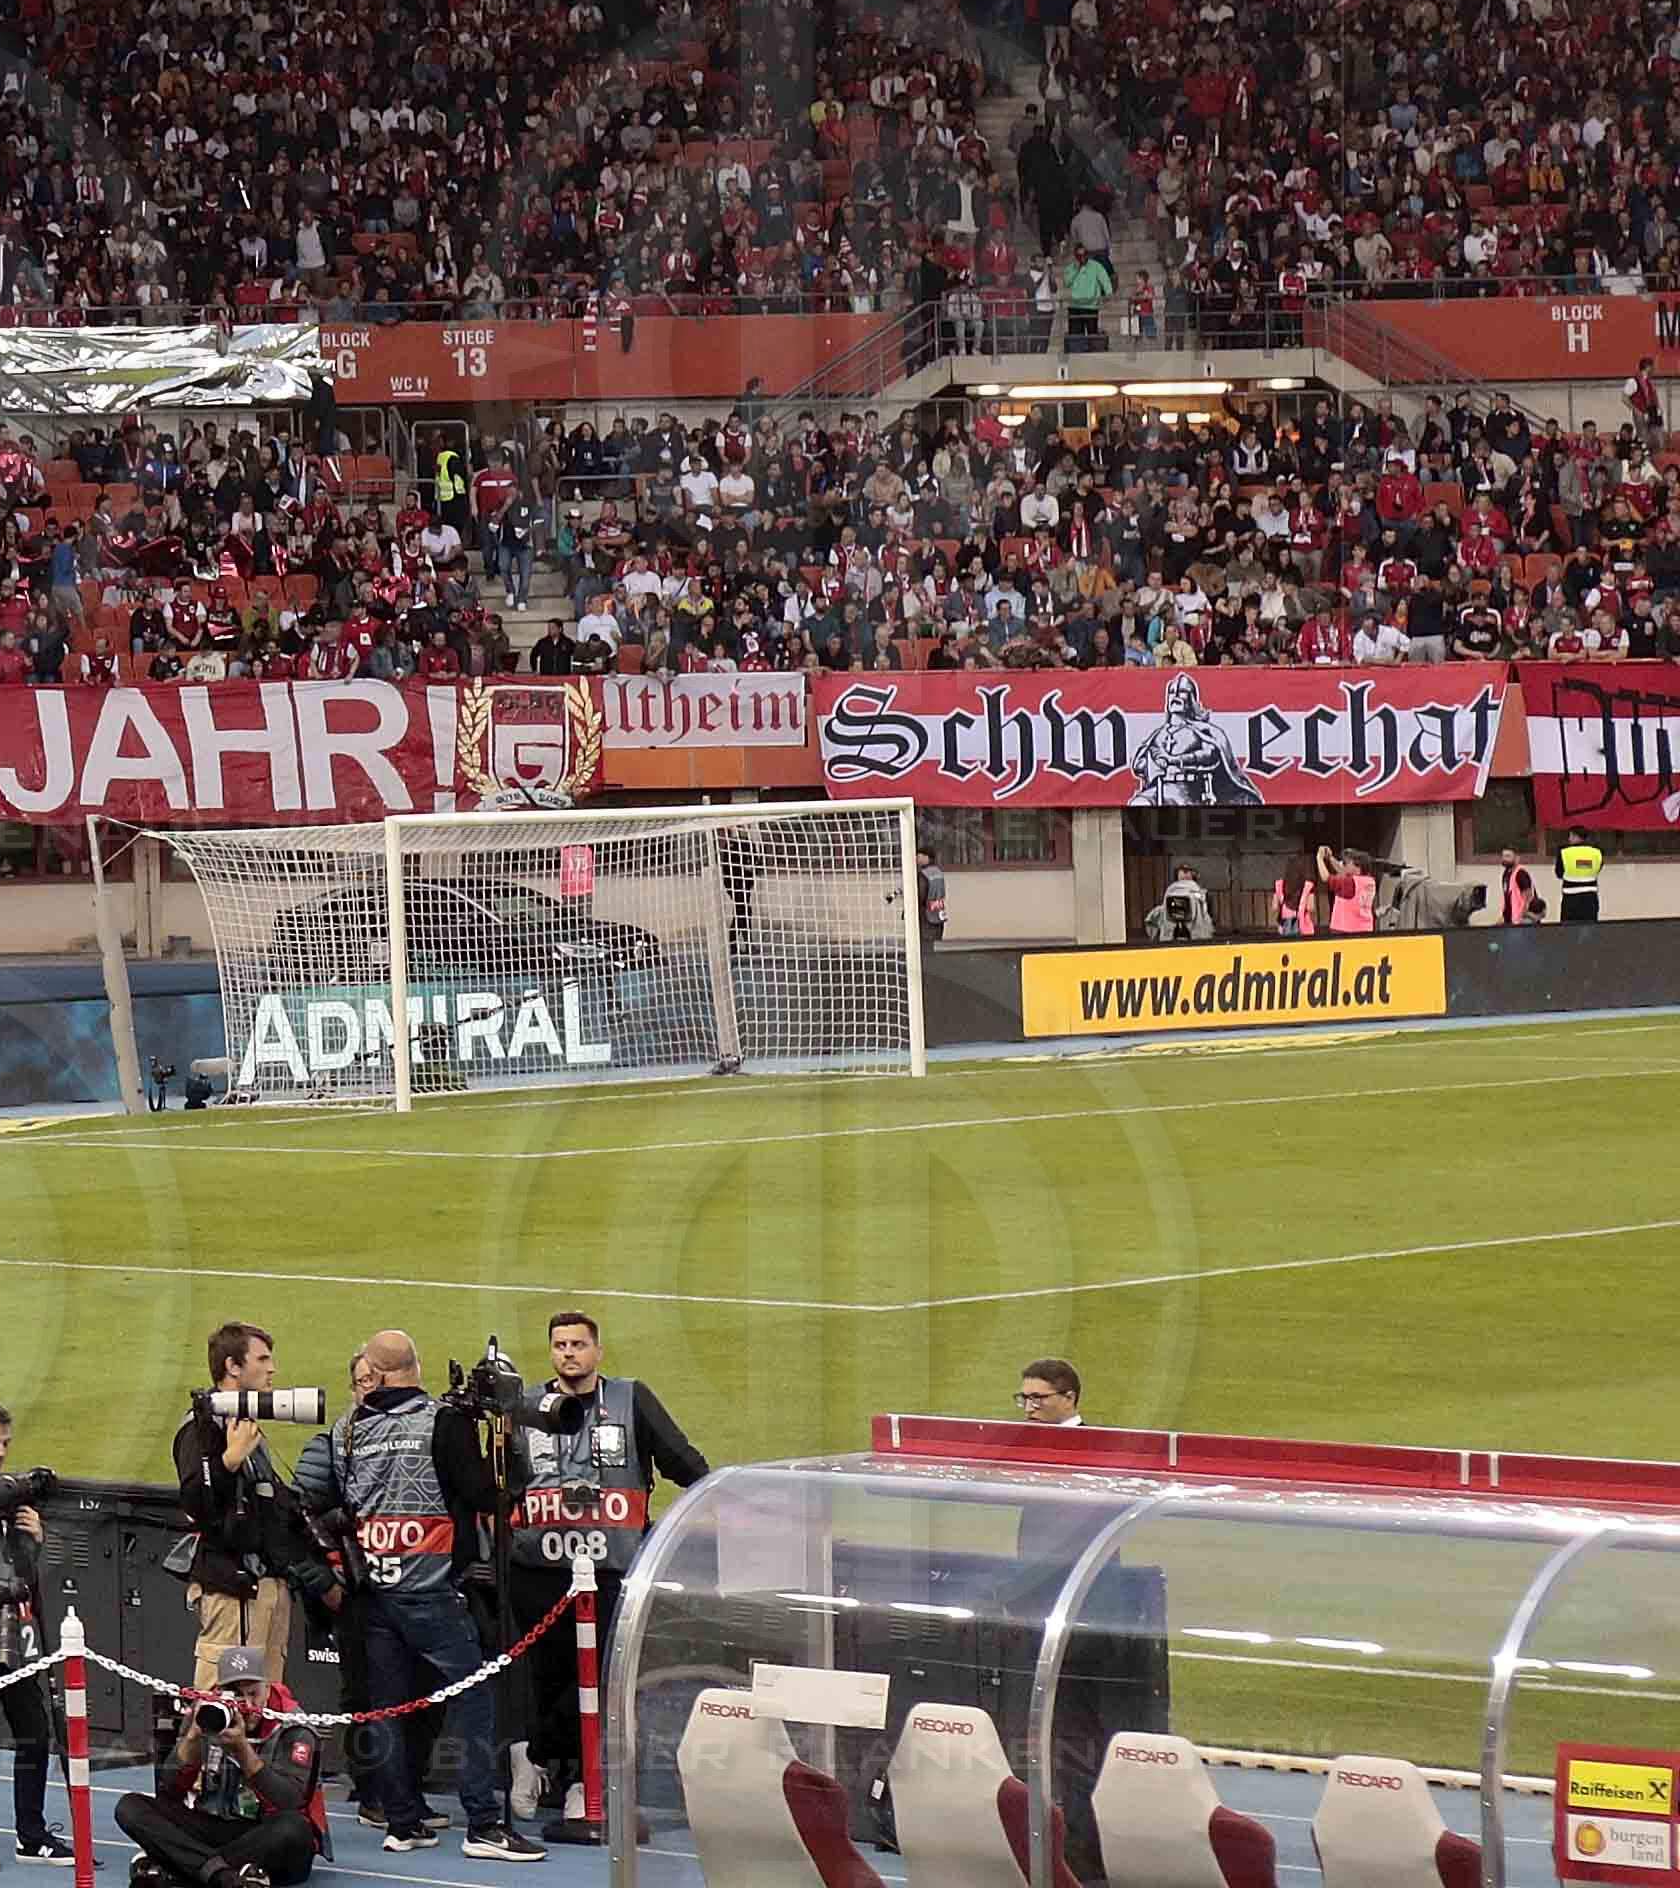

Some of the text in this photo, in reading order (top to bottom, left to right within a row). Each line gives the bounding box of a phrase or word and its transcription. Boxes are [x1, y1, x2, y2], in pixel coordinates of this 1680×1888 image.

[1551, 304, 1603, 321] BLOCK
[321, 332, 370, 348] BLOCK
[442, 330, 495, 345] STIEGE
[1567, 322, 1590, 353] H
[337, 350, 357, 379] G
[452, 348, 487, 377] 13
[390, 377, 412, 391] WC
[1080, 950, 1393, 1021] www.admiral.at
[238, 976, 612, 1086] ADMIRAL
[541, 1530, 608, 1561] 008
[912, 1717, 973, 1736] RECARO
[1114, 1745, 1179, 1765] RECARO
[1337, 1770, 1402, 1791] RECARO
[1570, 1780, 1645, 1801] Raiffeisen
[1610, 1827, 1665, 1848] burgen
[1631, 1845, 1666, 1864] land
